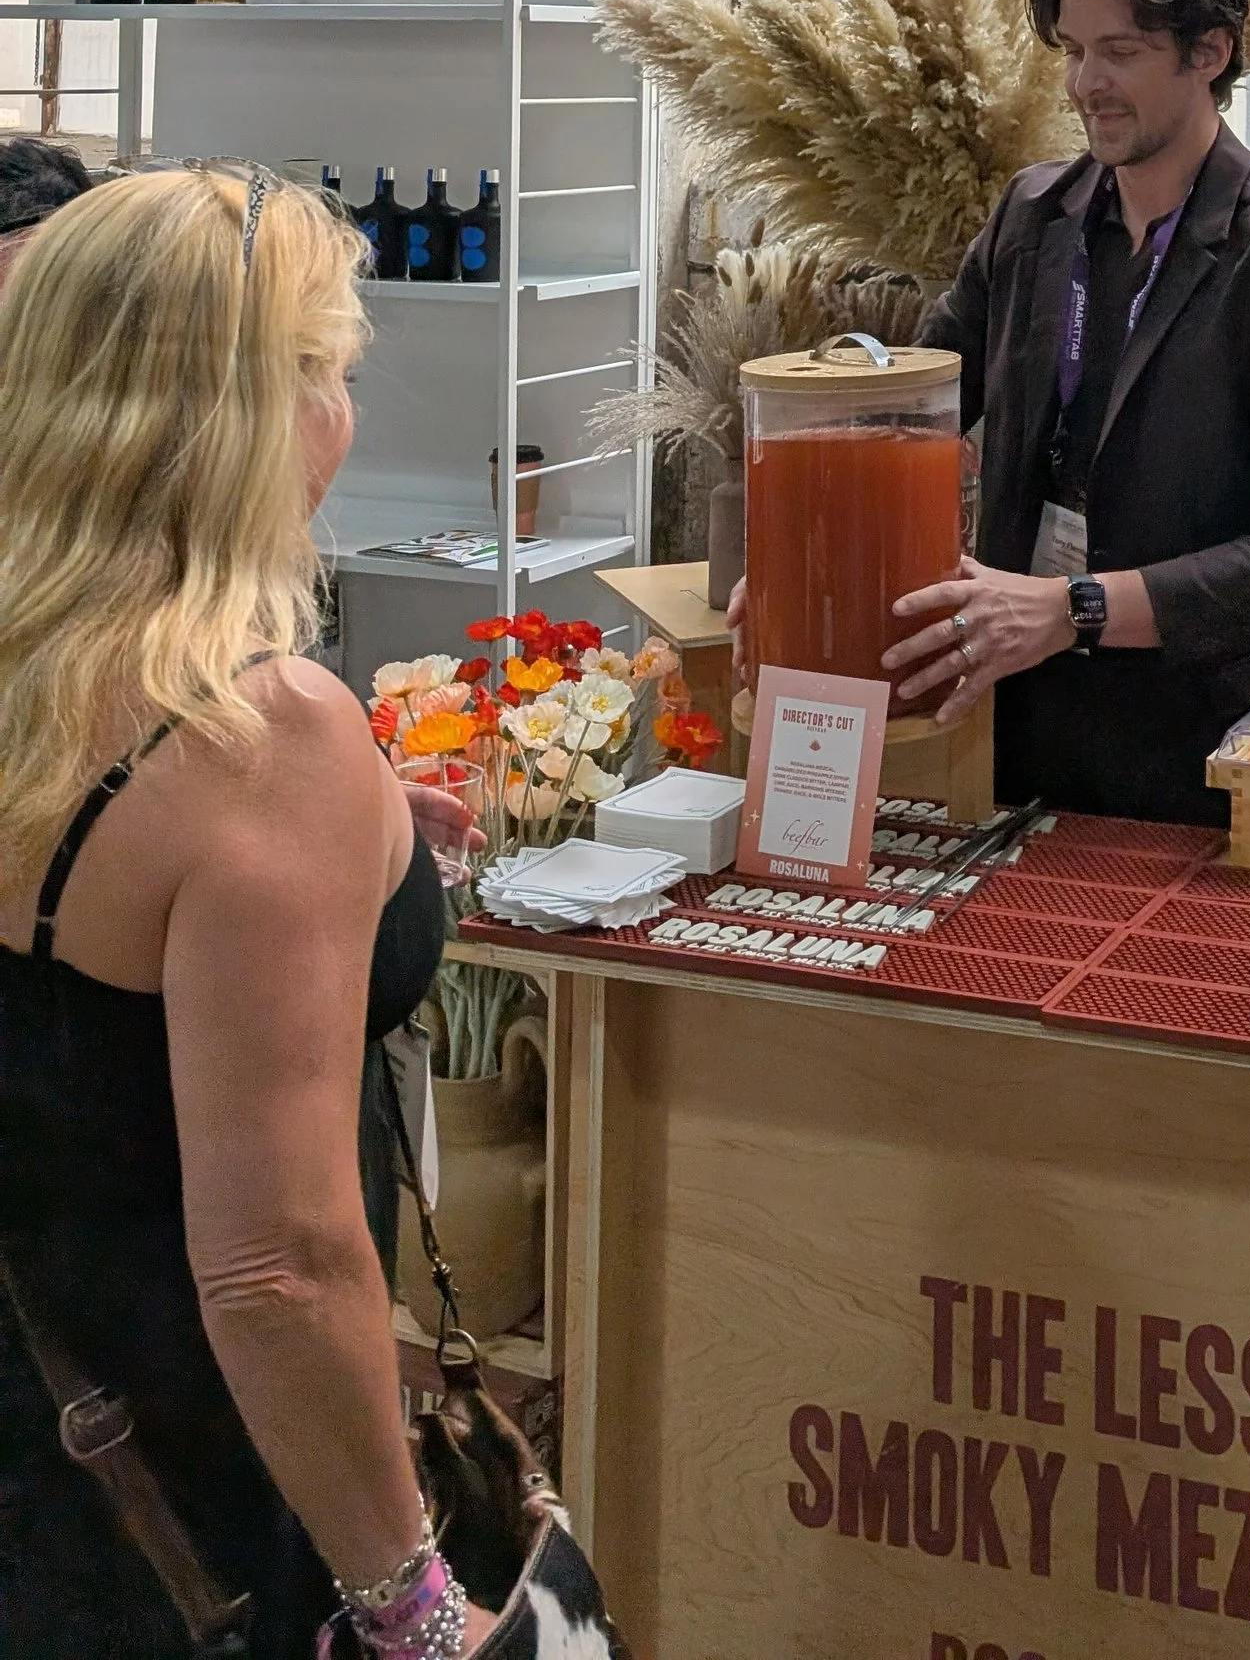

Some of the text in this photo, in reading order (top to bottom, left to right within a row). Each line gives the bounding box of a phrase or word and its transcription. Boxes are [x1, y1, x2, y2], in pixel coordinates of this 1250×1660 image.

[1071, 291, 1086, 361] SMARTTAB
[782, 708, 854, 731] DIRECTOR'S CUT
[782, 819, 829, 855] beefbar
[769, 859, 829, 883] ROSALUNA
[705, 883, 935, 934] ROSALUNA
[648, 918, 888, 970] ROSALUNA
[918, 1275, 1065, 1427] THE
[787, 1403, 1066, 1577] SMOKY
